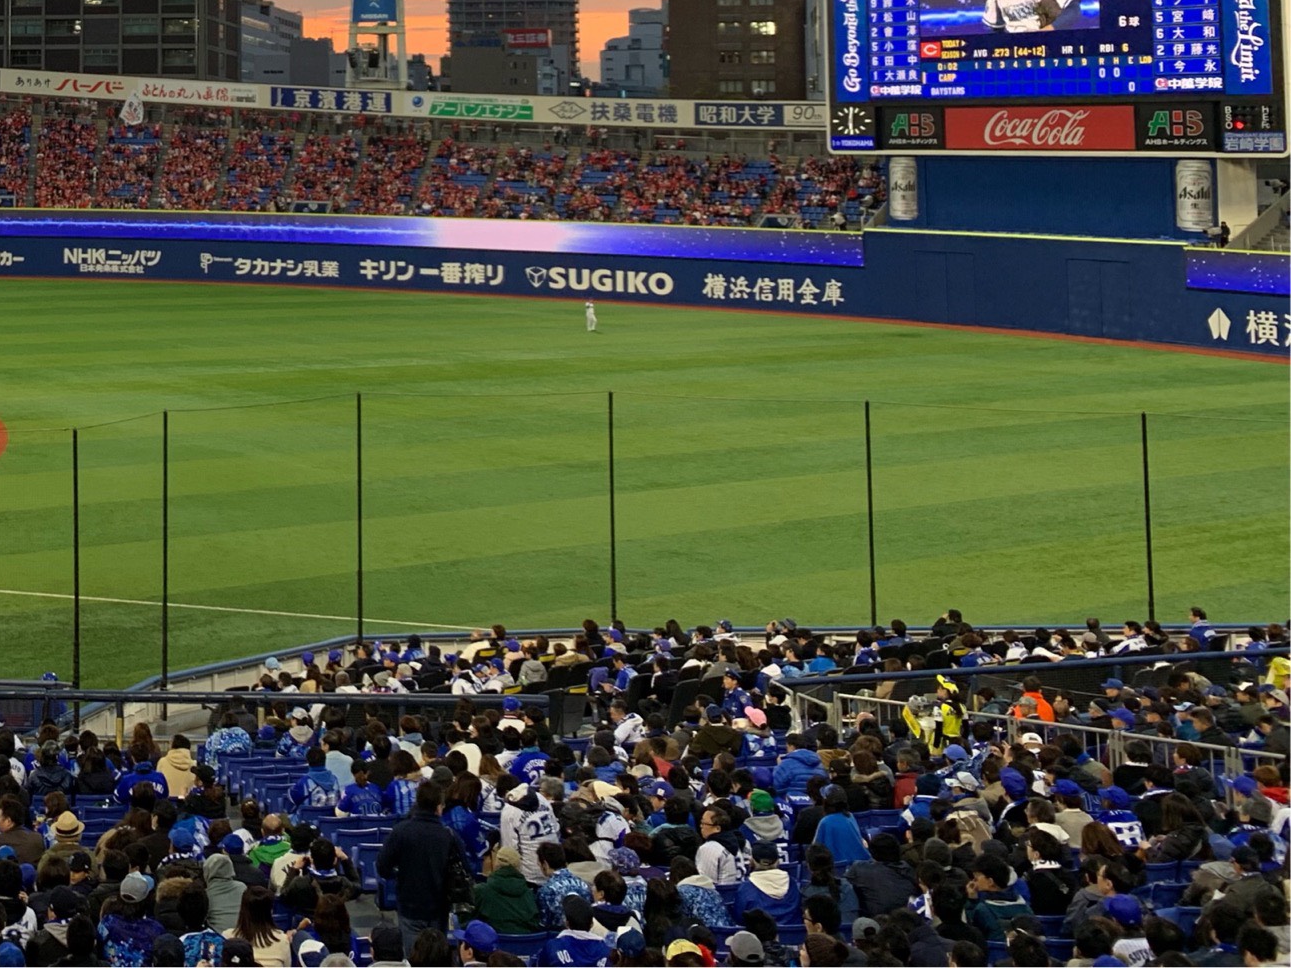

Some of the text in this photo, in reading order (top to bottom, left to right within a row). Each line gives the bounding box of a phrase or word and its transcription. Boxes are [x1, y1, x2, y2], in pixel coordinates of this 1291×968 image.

[871, 13, 877, 22] 7
[1155, 11, 1163, 22] 5
[1235, 10, 1252, 31] the
[842, 12, 860, 68] Beyond
[871, 28, 878, 37] 2
[1156, 26, 1215, 39] 6 大和
[872, 42, 878, 51] 5
[973, 43, 1129, 58] AVG .273 [44-12] HR 1 RBI 6
[1156, 43, 1217, 55] 2 伊藤光
[872, 55, 917, 66] 6 田中
[1099, 57, 1105, 65] R
[1113, 57, 1120, 65] H
[1159, 59, 1217, 72] 1 今永
[843, 69, 862, 92] Go
[873, 71, 878, 80] 1
[938, 67, 1120, 82] CARP 0 0
[930, 82, 1136, 96] BAYSTARS 0
[293, 88, 388, 112] 京濱港運
[699, 106, 775, 124] 昭和大学
[984, 109, 1088, 146] Coca-Cola
[1145, 138, 1208, 146] AHSホールディングス
[234, 258, 340, 278] タカナシ乳業
[360, 259, 504, 285] キリン 一番搾り
[548, 266, 674, 296] SUGIKO
[702, 272, 846, 307] 横浜信用金庫
[527, 815, 556, 840] 25
